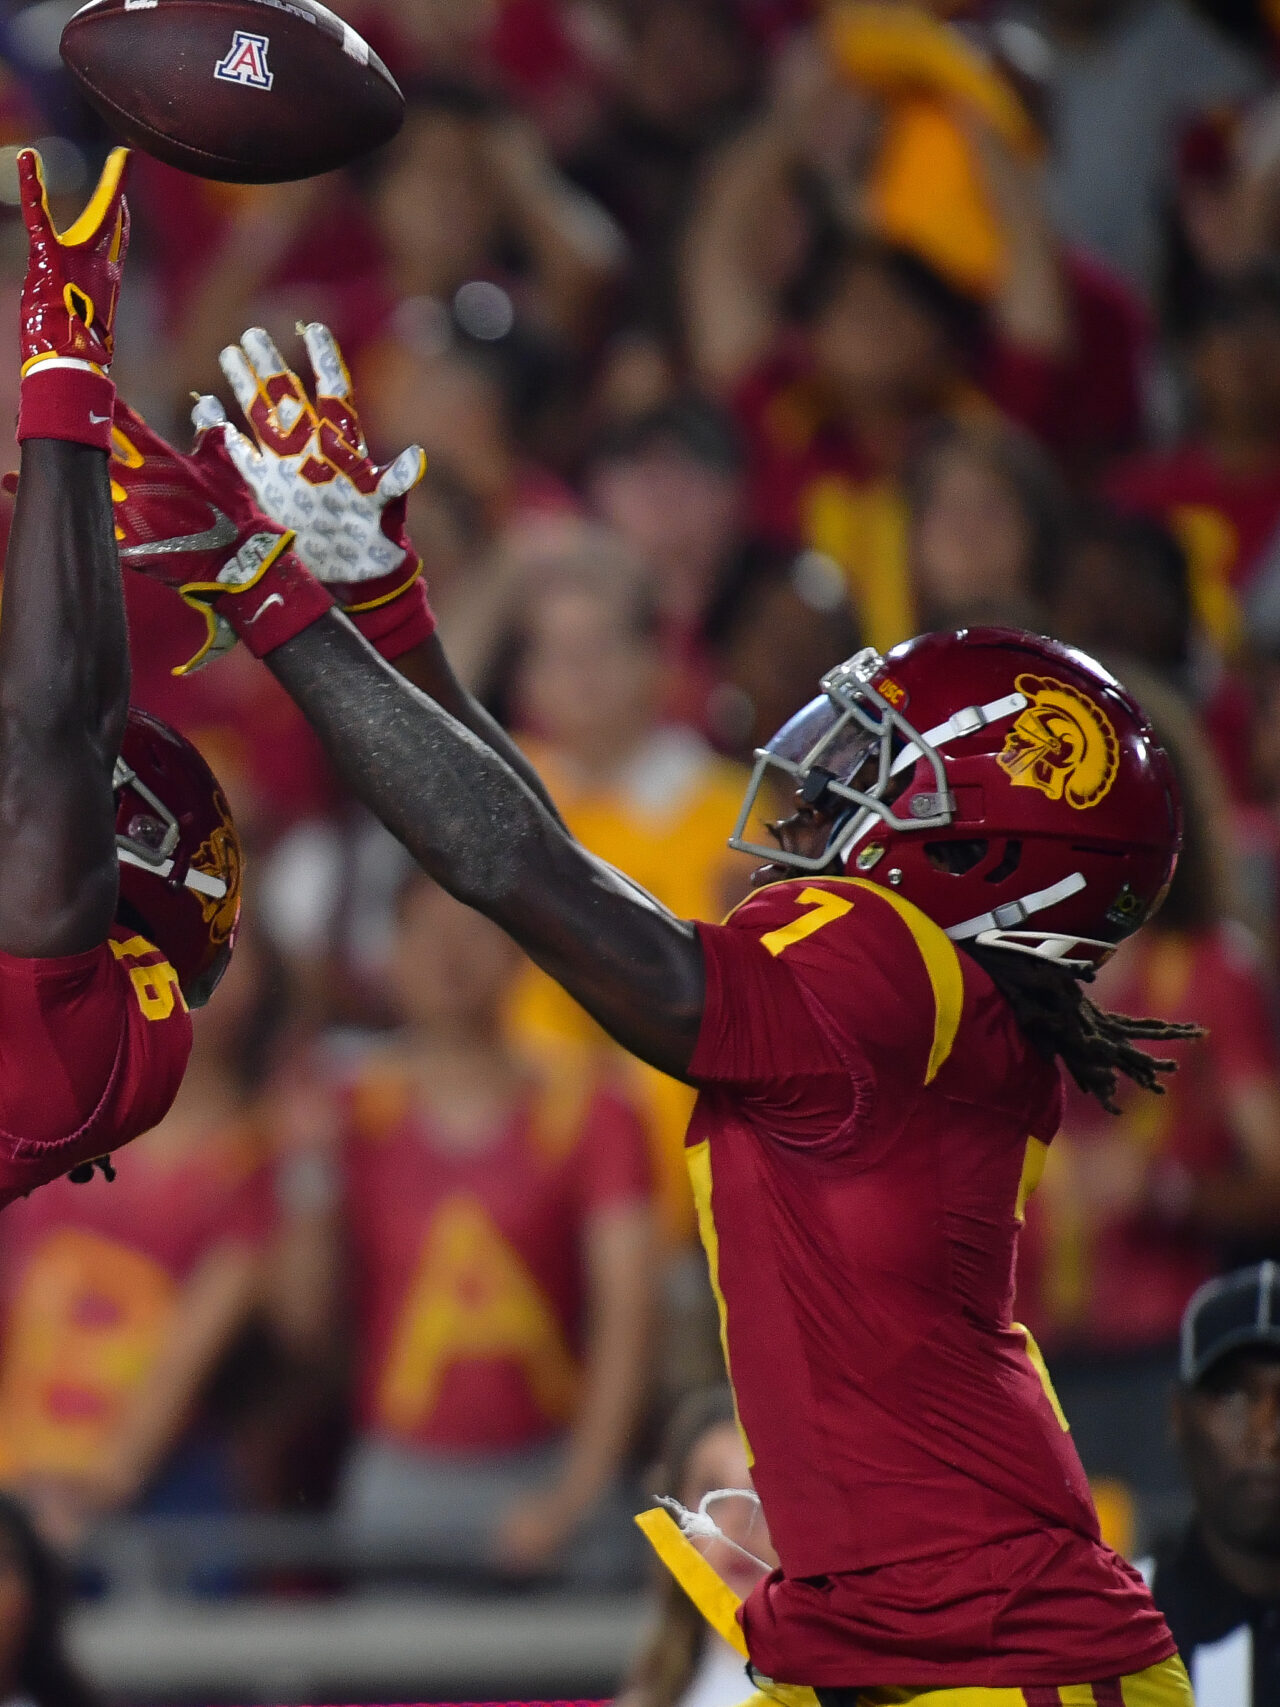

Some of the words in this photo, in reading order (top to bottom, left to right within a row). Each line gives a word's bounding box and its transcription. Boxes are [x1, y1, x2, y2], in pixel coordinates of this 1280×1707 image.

[213, 30, 273, 91] A
[878, 678, 905, 704] USC
[760, 886, 855, 957] 7
[108, 934, 189, 1021] 16
